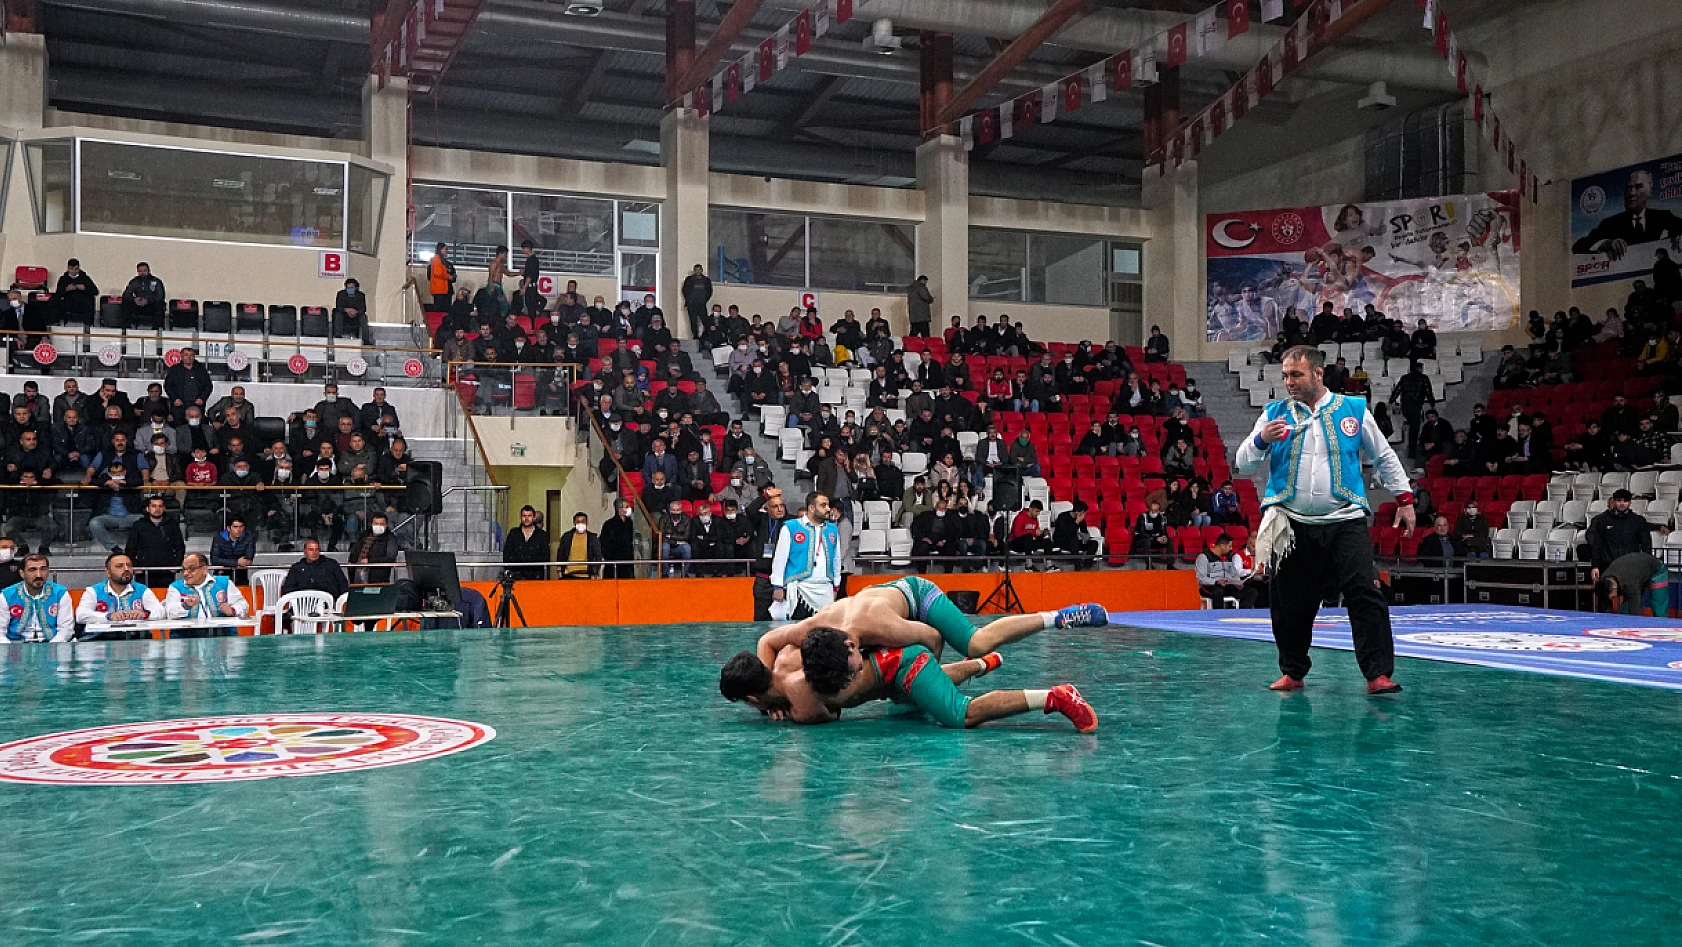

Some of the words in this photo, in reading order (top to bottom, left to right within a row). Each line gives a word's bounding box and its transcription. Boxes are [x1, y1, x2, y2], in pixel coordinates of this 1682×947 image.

[325, 253, 341, 271] B
[538, 277, 552, 293] C
[802, 293, 815, 309] C
[214, 764, 334, 777] Spor
